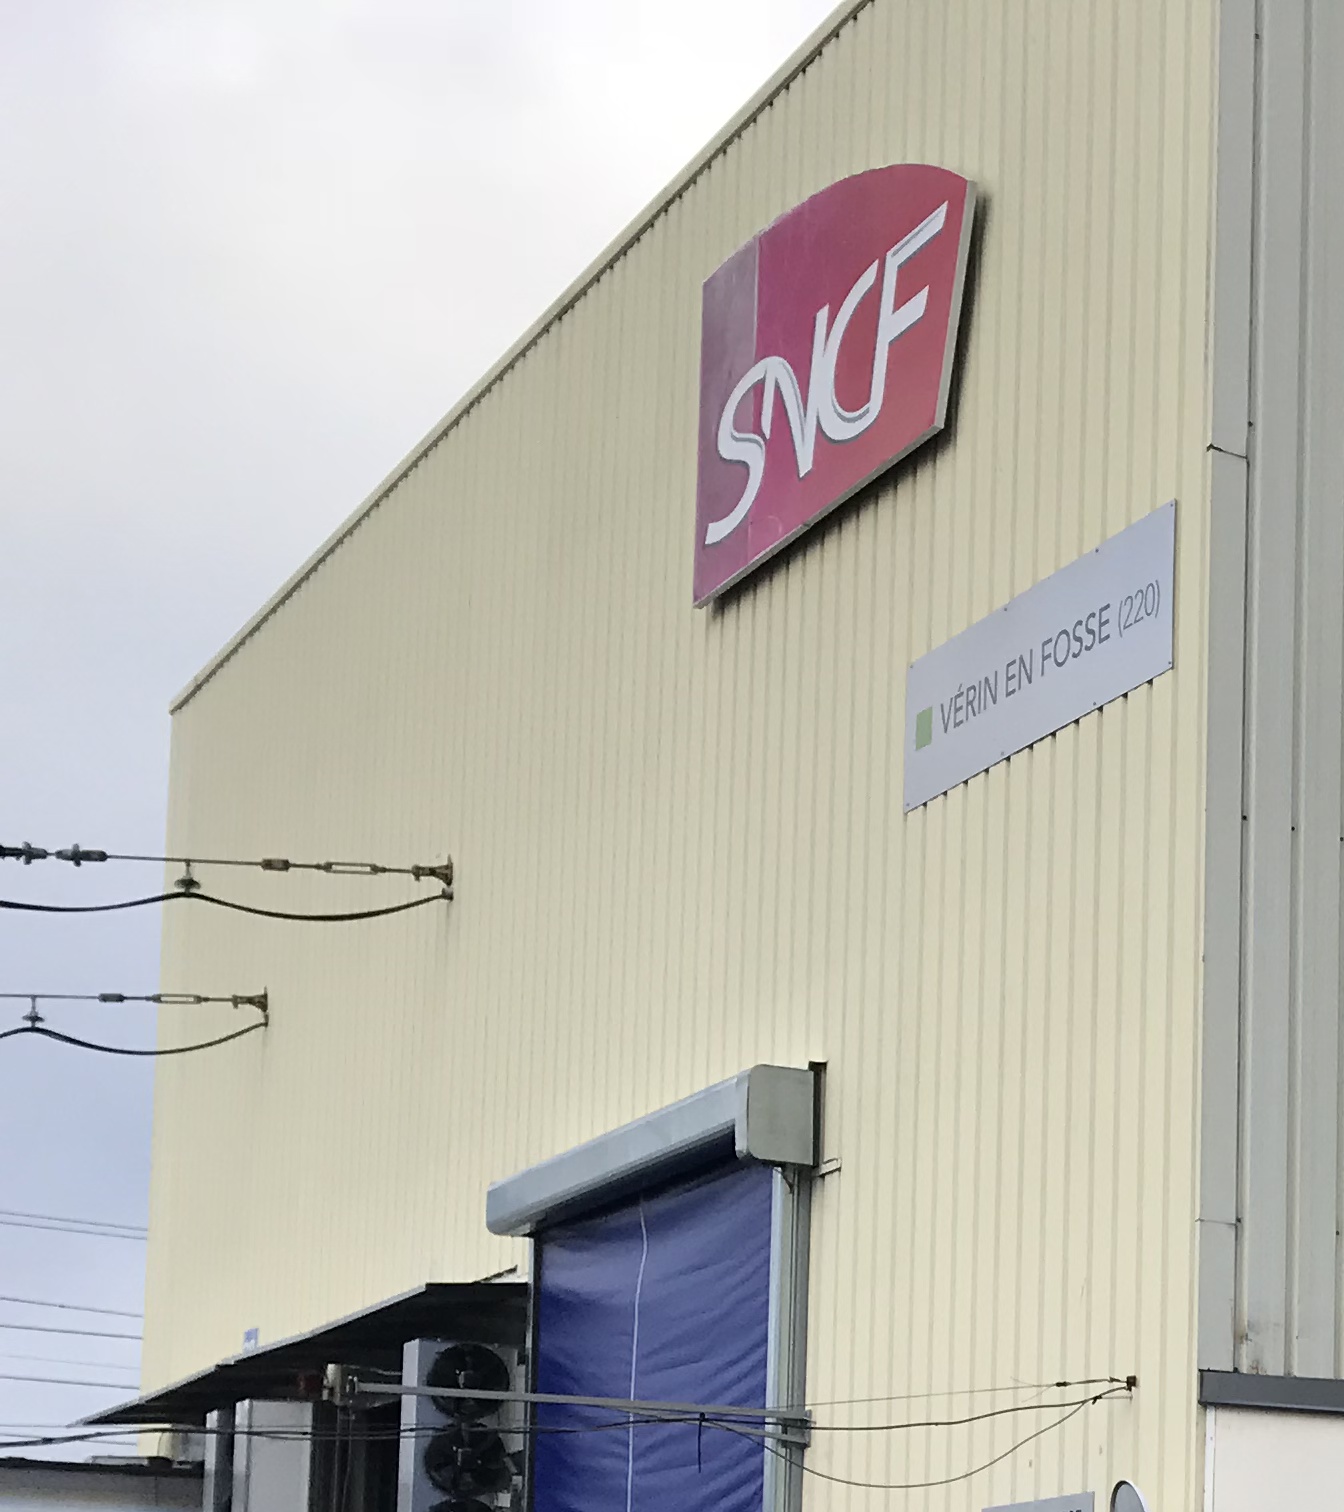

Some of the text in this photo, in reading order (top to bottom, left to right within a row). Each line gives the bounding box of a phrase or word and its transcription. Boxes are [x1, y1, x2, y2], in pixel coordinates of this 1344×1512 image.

[705, 200, 949, 545] SNCF
[940, 579, 1161, 734] VÉRIN EN FOSSE (220)
